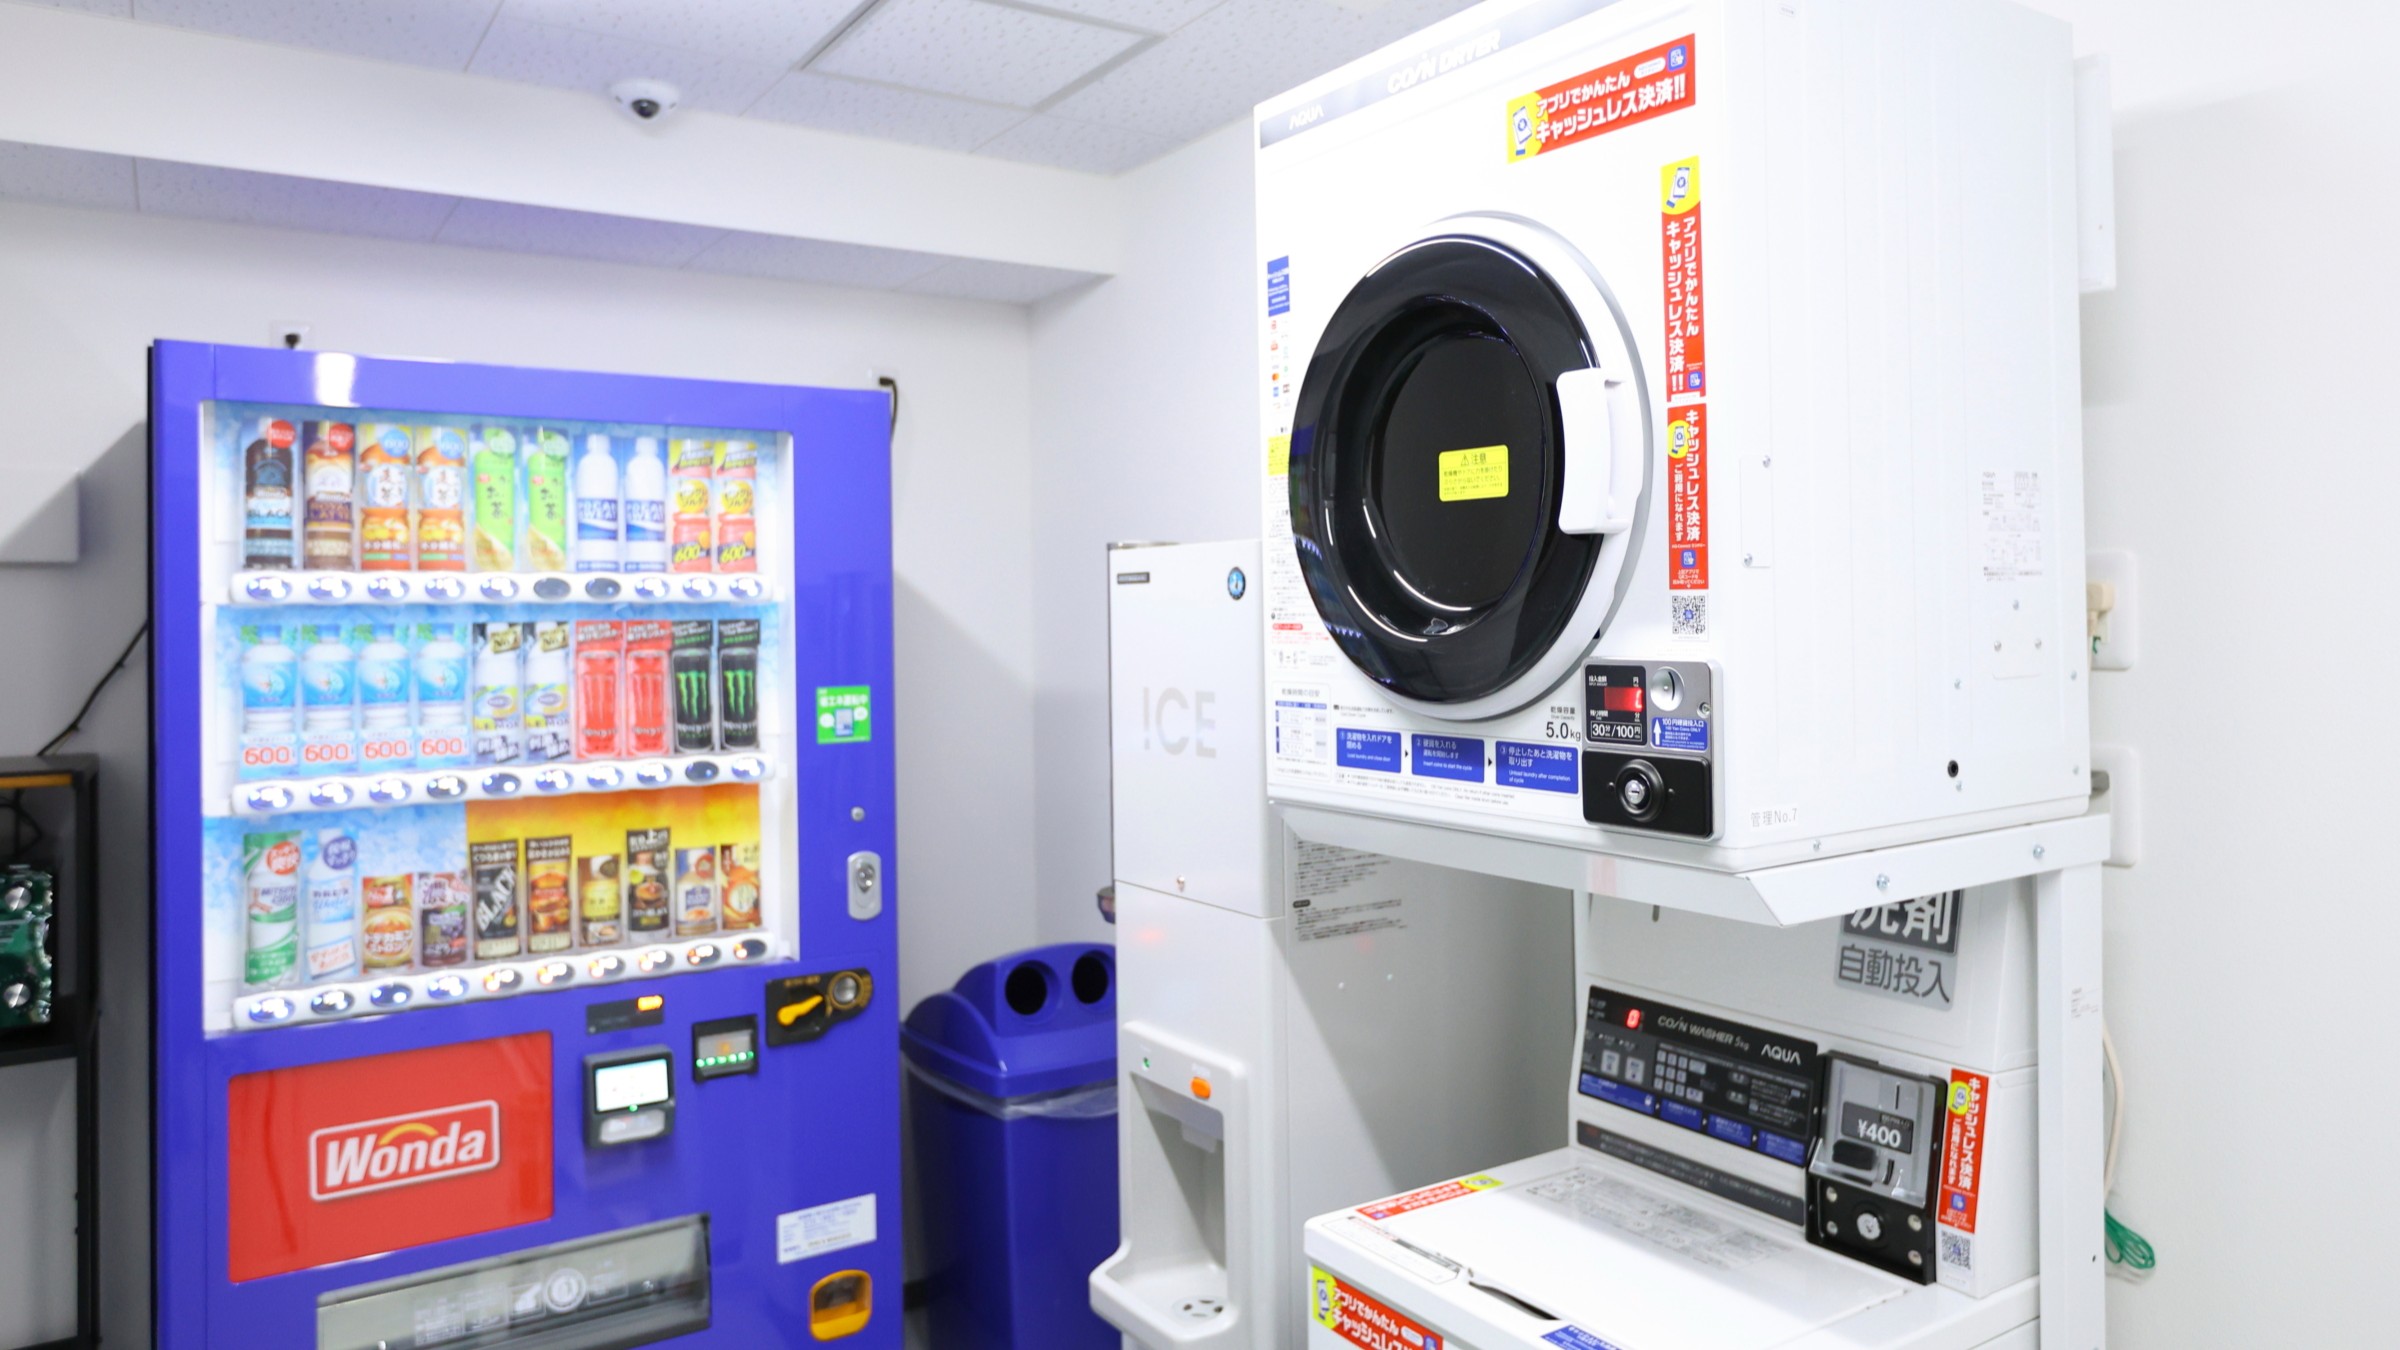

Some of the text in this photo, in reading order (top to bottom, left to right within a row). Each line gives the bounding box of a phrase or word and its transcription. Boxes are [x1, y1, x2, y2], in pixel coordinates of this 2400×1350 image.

[1438, 30, 1500, 75] DRYER
[1536, 71, 1631, 118] アプリでかんたん
[1288, 103, 1325, 130] AQUA
[1683, 216, 1699, 337] アプリでかんたん
[1472, 453, 1486, 465] 注意
[1686, 409, 1700, 542] キャッシュレス決済
[1674, 464, 1684, 542] ご利用になれます
[675, 544, 701, 563] 600
[720, 545, 746, 563] 600
[1550, 706, 1575, 715] 乾燥容量
[244, 746, 290, 765] 600
[304, 743, 349, 762] 600
[364, 740, 408, 759] 600
[421, 738, 463, 756] 600
[1508, 747, 1573, 761] 停止したあと洗濯物を
[1508, 758, 1533, 768] 取り出す
[1750, 808, 1797, 828] 管理No.7
[476, 864, 516, 932] BLACK
[1838, 944, 1950, 1003] 自動投入
[1689, 1024, 1734, 1044] WASHER
[1761, 1043, 1802, 1066] AQUA
[1858, 1118, 1901, 1148] ¥400
[1958, 1077, 1981, 1190] キャッシュレス決済
[326, 1121, 486, 1187] Wonda
[1333, 1287, 1399, 1337] アプリでかんたん
